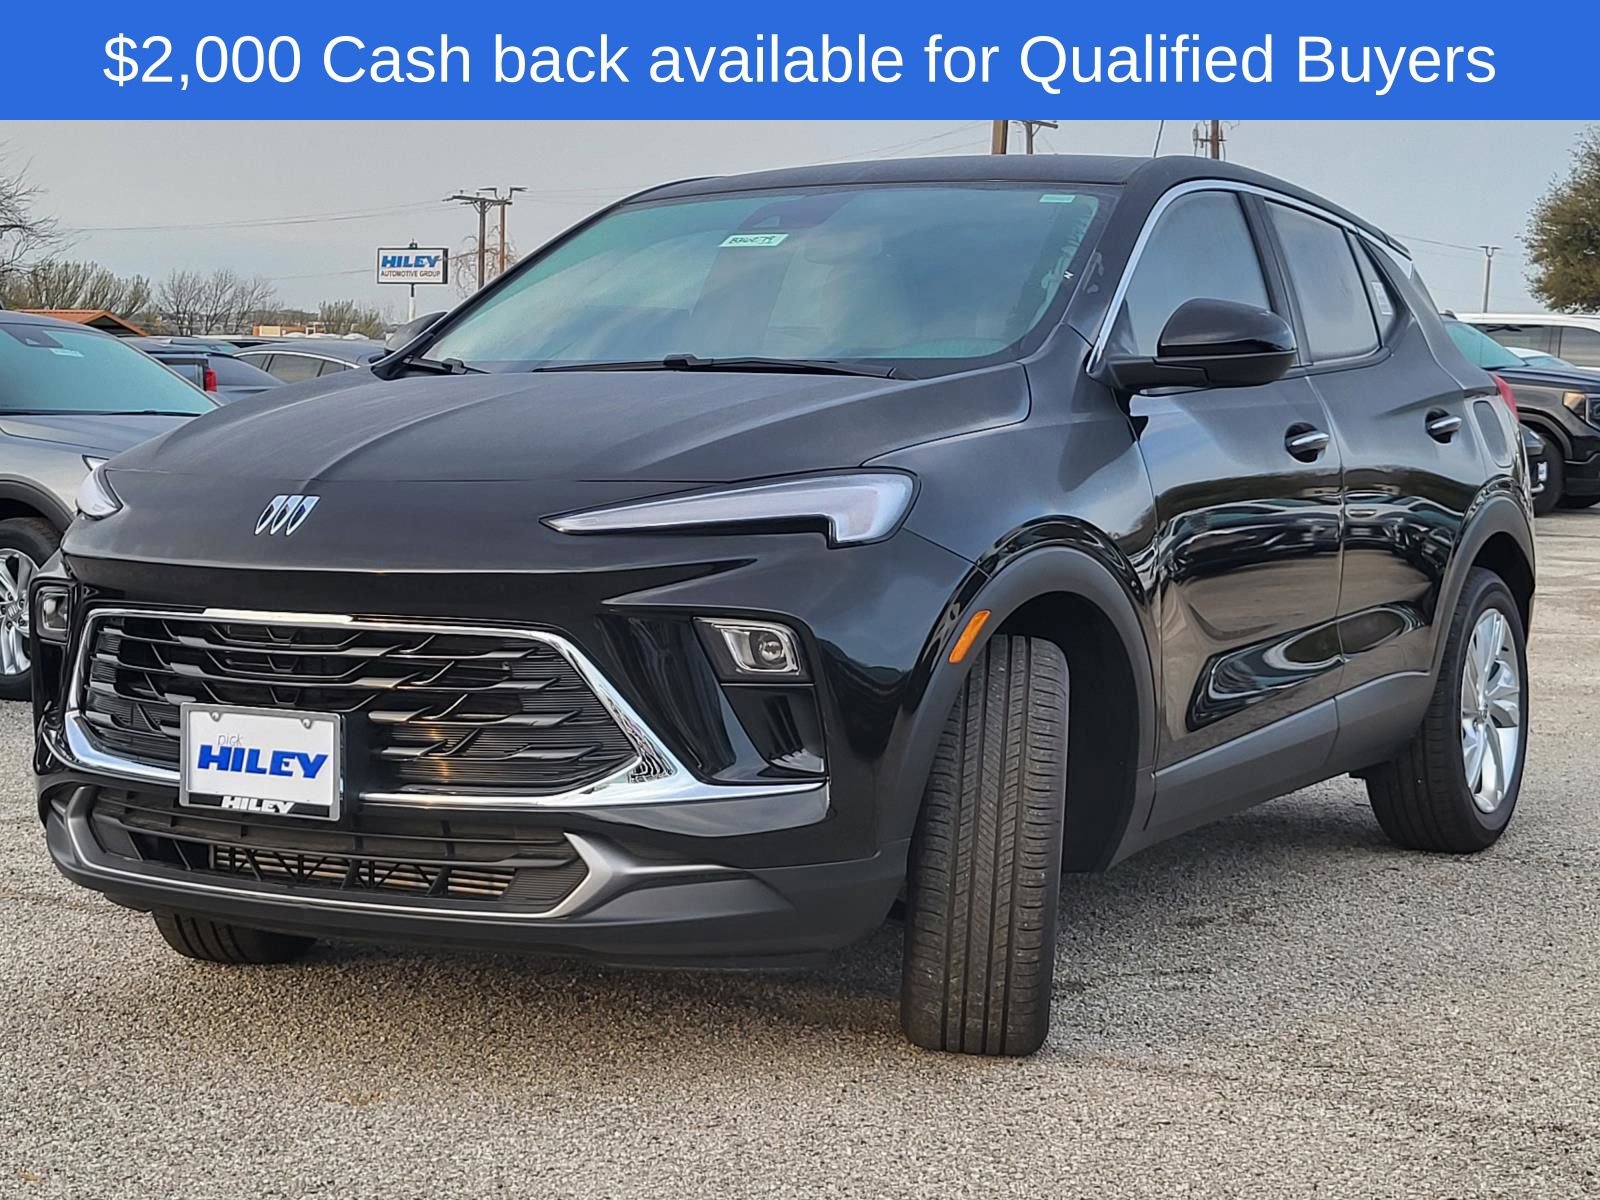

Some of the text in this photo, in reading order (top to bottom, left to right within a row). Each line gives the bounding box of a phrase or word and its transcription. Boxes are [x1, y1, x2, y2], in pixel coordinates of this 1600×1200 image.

[381, 255, 441, 268] HILEY
[381, 270, 418, 278] AUTOMOTIVE
[197, 744, 328, 779] HILEY
[220, 795, 295, 814] HILEY
